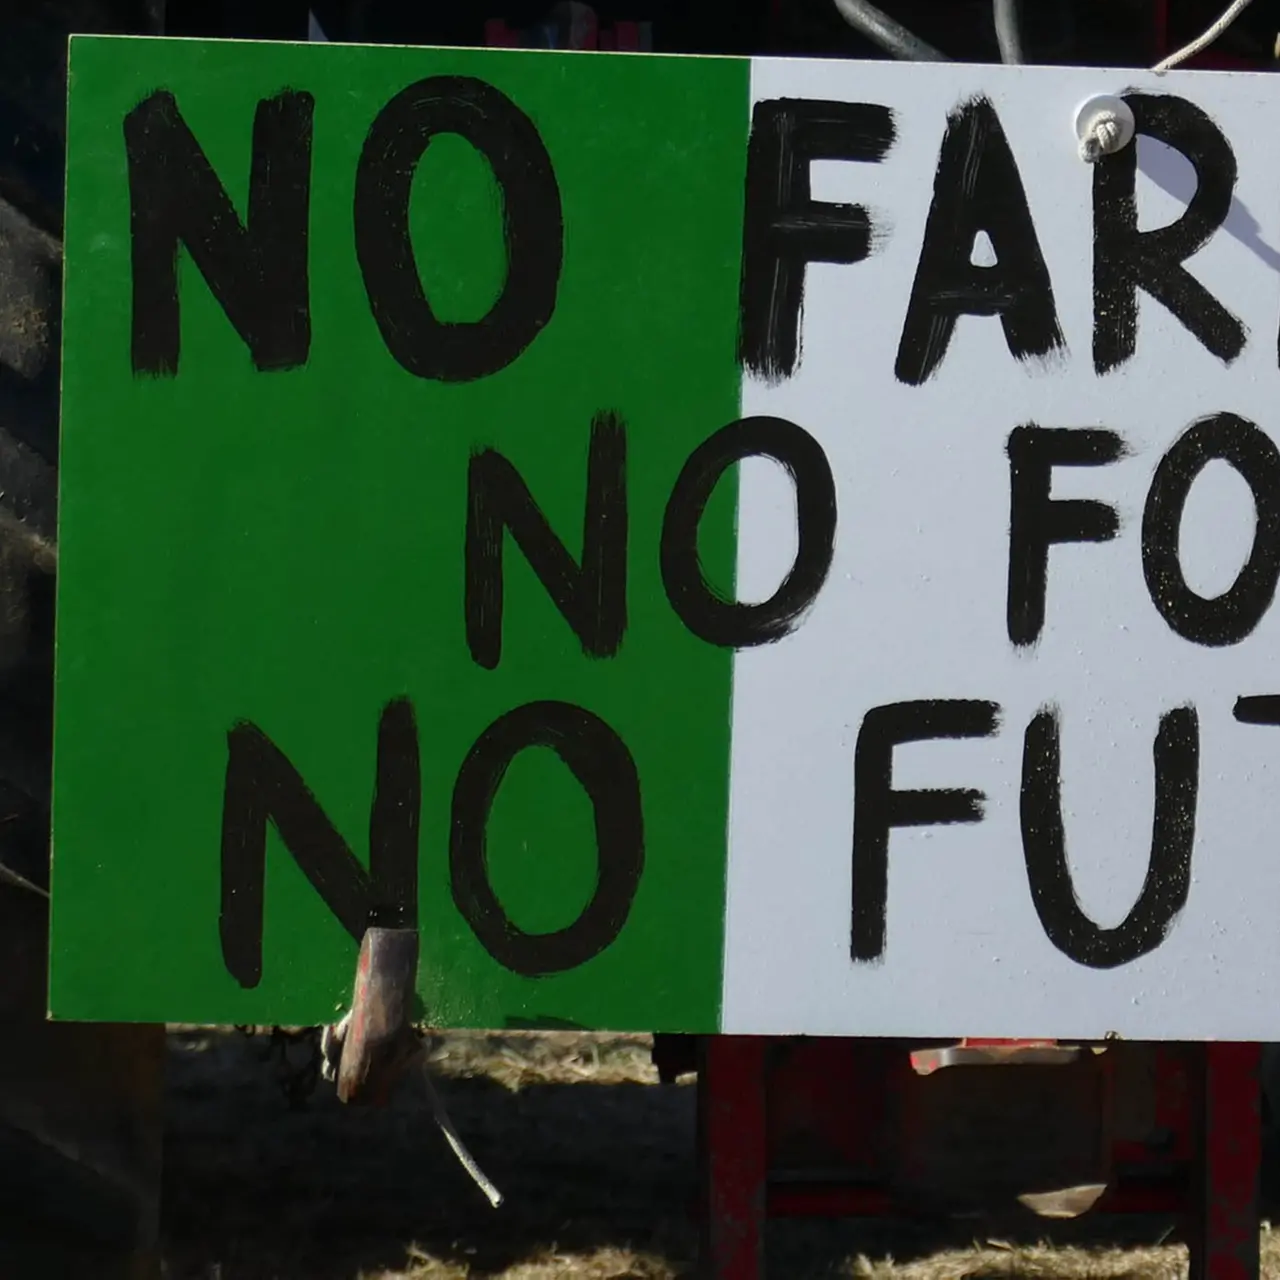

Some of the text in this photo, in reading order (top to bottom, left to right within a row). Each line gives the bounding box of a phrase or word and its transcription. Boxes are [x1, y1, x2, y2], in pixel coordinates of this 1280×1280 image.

[123, 74, 565, 382] NO
[464, 409, 838, 670] NO
[218, 694, 646, 990] NO
